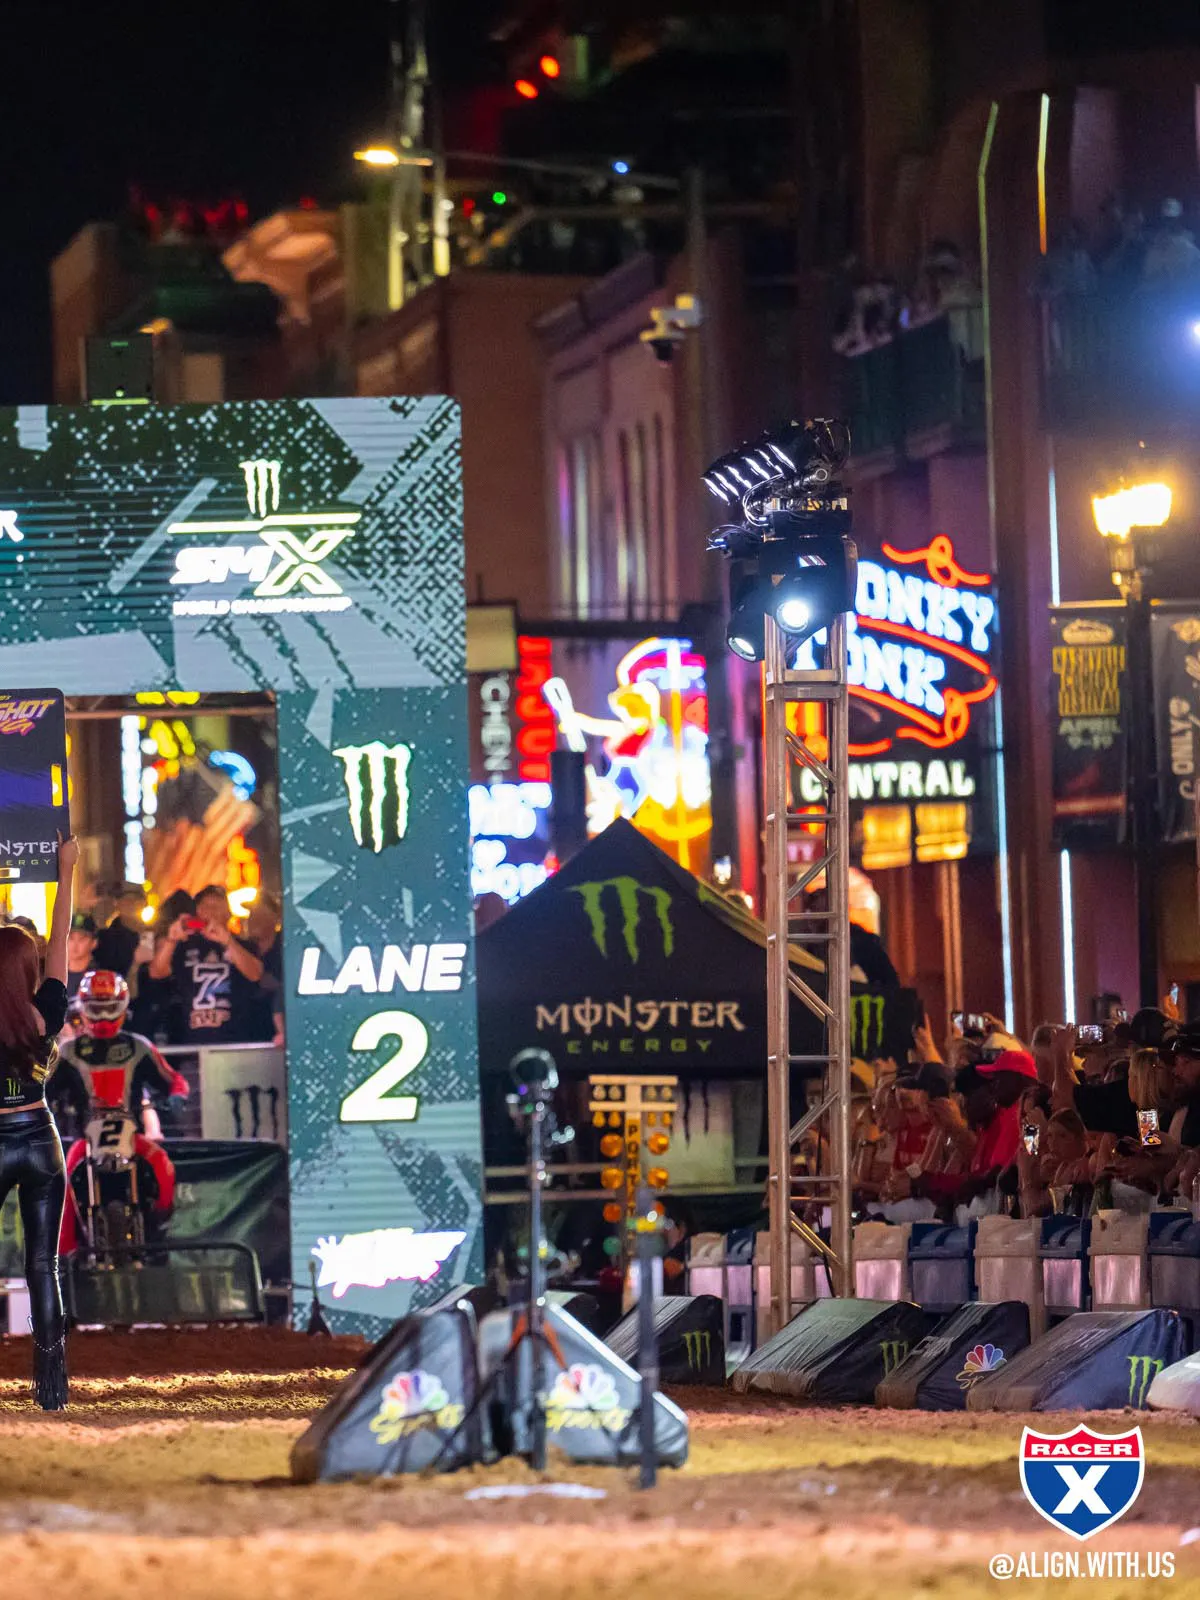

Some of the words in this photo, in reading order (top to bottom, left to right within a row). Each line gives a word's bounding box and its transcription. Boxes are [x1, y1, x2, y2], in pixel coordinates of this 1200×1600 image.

[854, 559, 994, 652] ONKY
[800, 760, 975, 803] CNTRAL
[297, 943, 467, 995] LANE
[535, 995, 745, 1034] MONSTER
[340, 1010, 429, 1121] 2
[567, 1038, 712, 1054] ENERGY
[98, 1120, 123, 1146] 2
